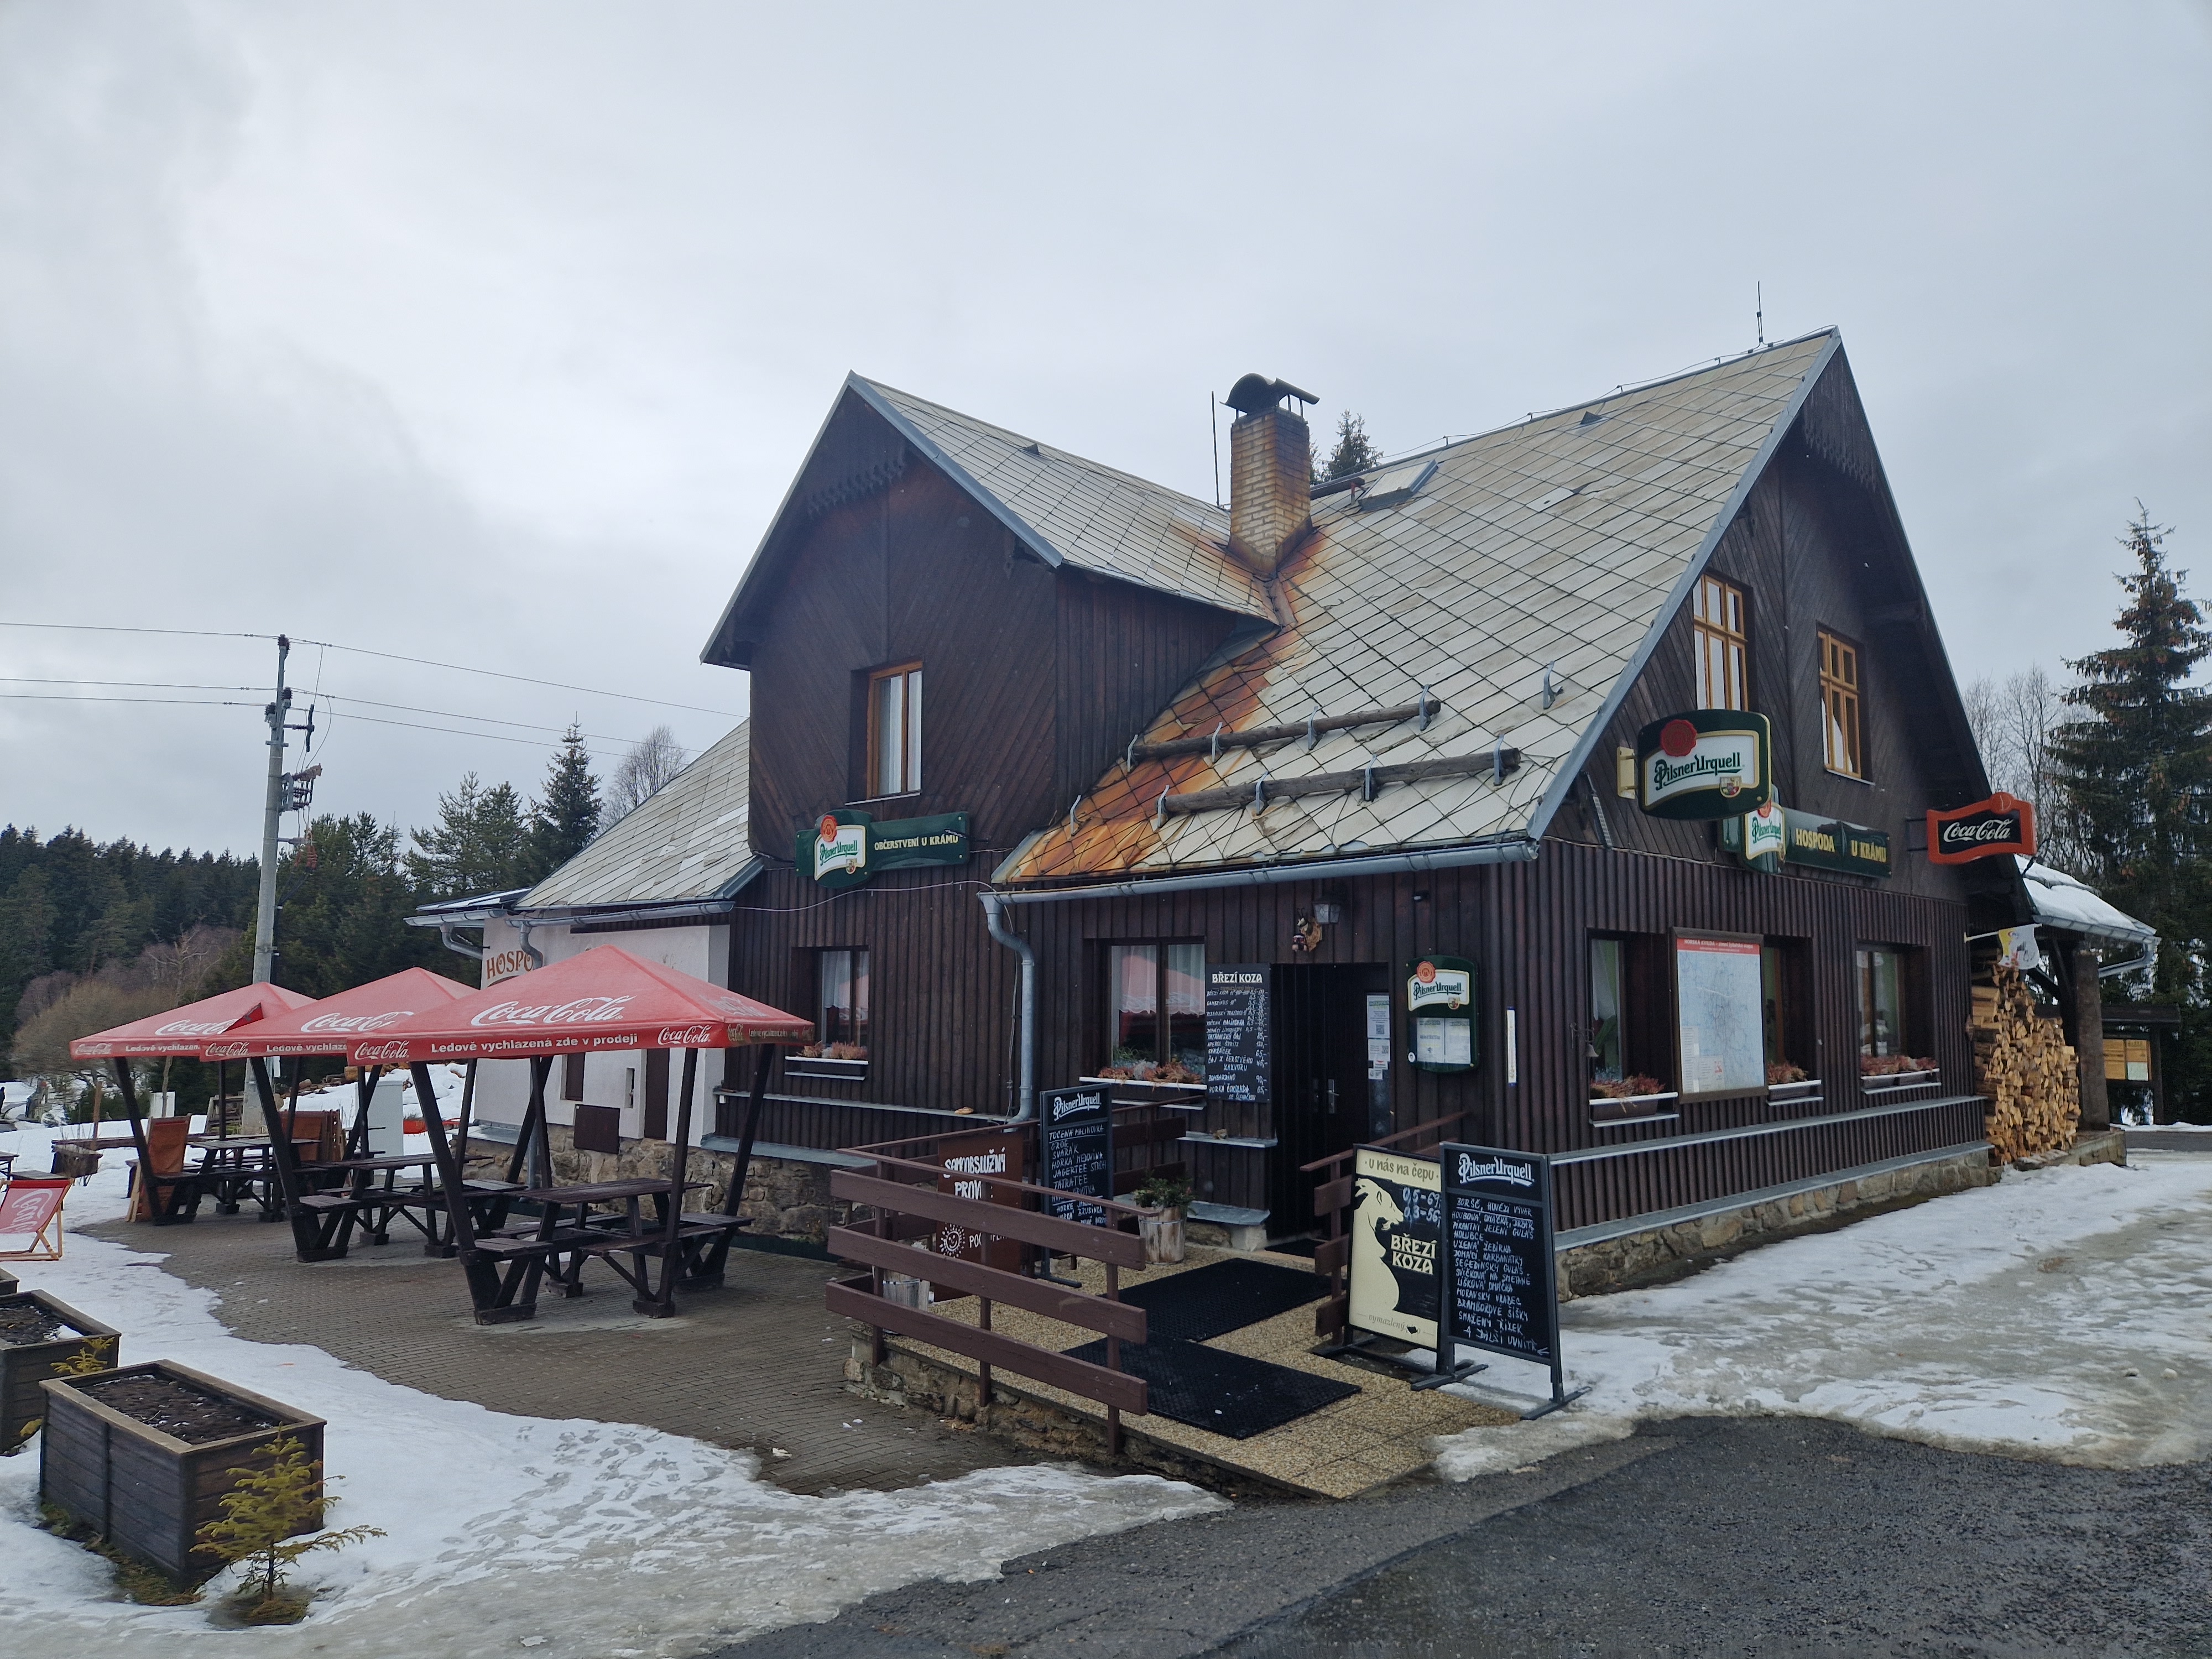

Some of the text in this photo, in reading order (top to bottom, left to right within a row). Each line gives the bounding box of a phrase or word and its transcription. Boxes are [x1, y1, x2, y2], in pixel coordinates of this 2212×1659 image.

[1654, 752, 1741, 791] Pilsner Urquell
[1752, 816, 1771, 843] Pilsner
[1943, 818, 2014, 842] Coca-Cola
[874, 833, 958, 851] OBČERSTVENÍ U KRÁMU
[1796, 828, 1835, 853] HOSPODA
[820, 840, 857, 866] Pilsner Urquell
[1851, 840, 1886, 863] U KRÁMU
[487, 951, 543, 979] HOSPO
[1212, 971, 1262, 983] BŘEZÍ KOZA
[1413, 981, 1462, 1000] Pilsner Urquell
[471, 995, 637, 1026] Coca-Cola
[155, 1019, 239, 1035] Coca-C
[301, 1011, 414, 1032] Coca-C
[431, 1041, 477, 1053] Ledově
[481, 1037, 552, 1052] vychlazená
[556, 1037, 578, 1046] zde
[593, 1034, 638, 1046] prodeji
[658, 1025, 712, 1045] Coca-Cola
[205, 1042, 249, 1057] Coca-Cola
[267, 1042, 347, 1052] Ledově vychlaze
[354, 1040, 409, 1060] Coca-Cola
[1053, 1092, 1100, 1121] Pilsner Urquell
[1075, 1124, 1104, 1136] MALINOVKA
[1051, 1140, 1069, 1150] GROG
[1369, 1157, 1434, 1182] u nás na čepu
[1458, 1153, 1532, 1185] Pilsner Urquell
[1053, 1175, 1088, 1190] TATRATEE
[1454, 1230, 1484, 1241] HOLUBCE
[1391, 1233, 1437, 1259] BŘEZÍ
[1392, 1251, 1433, 1275] KOZA
[1490, 1272, 1498, 1281] NA
[1496, 1293, 1522, 1306] VRABEC
[1369, 1314, 1405, 1331] vymazlený
[1463, 1326, 1471, 1338] A
